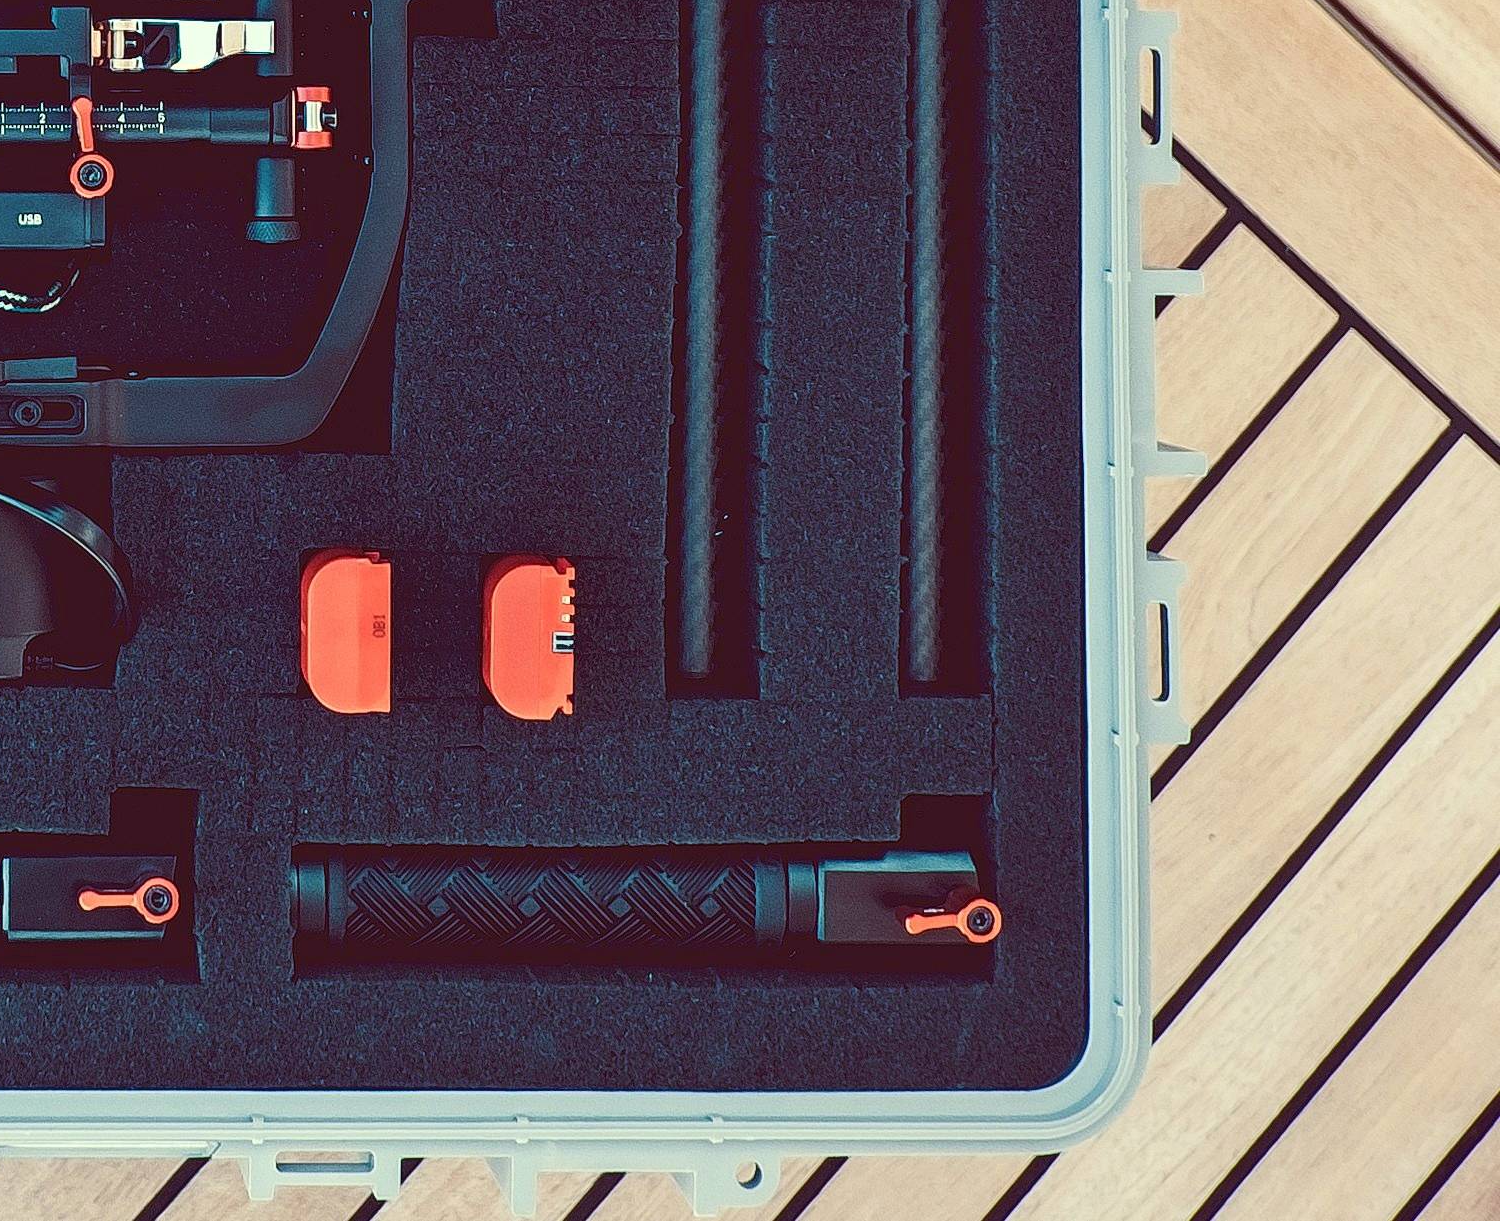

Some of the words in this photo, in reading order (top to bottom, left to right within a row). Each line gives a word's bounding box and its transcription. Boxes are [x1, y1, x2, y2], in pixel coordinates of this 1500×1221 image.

[38, 113, 47, 124] 2
[117, 113, 127, 124] 4
[18, 213, 43, 226] USB
